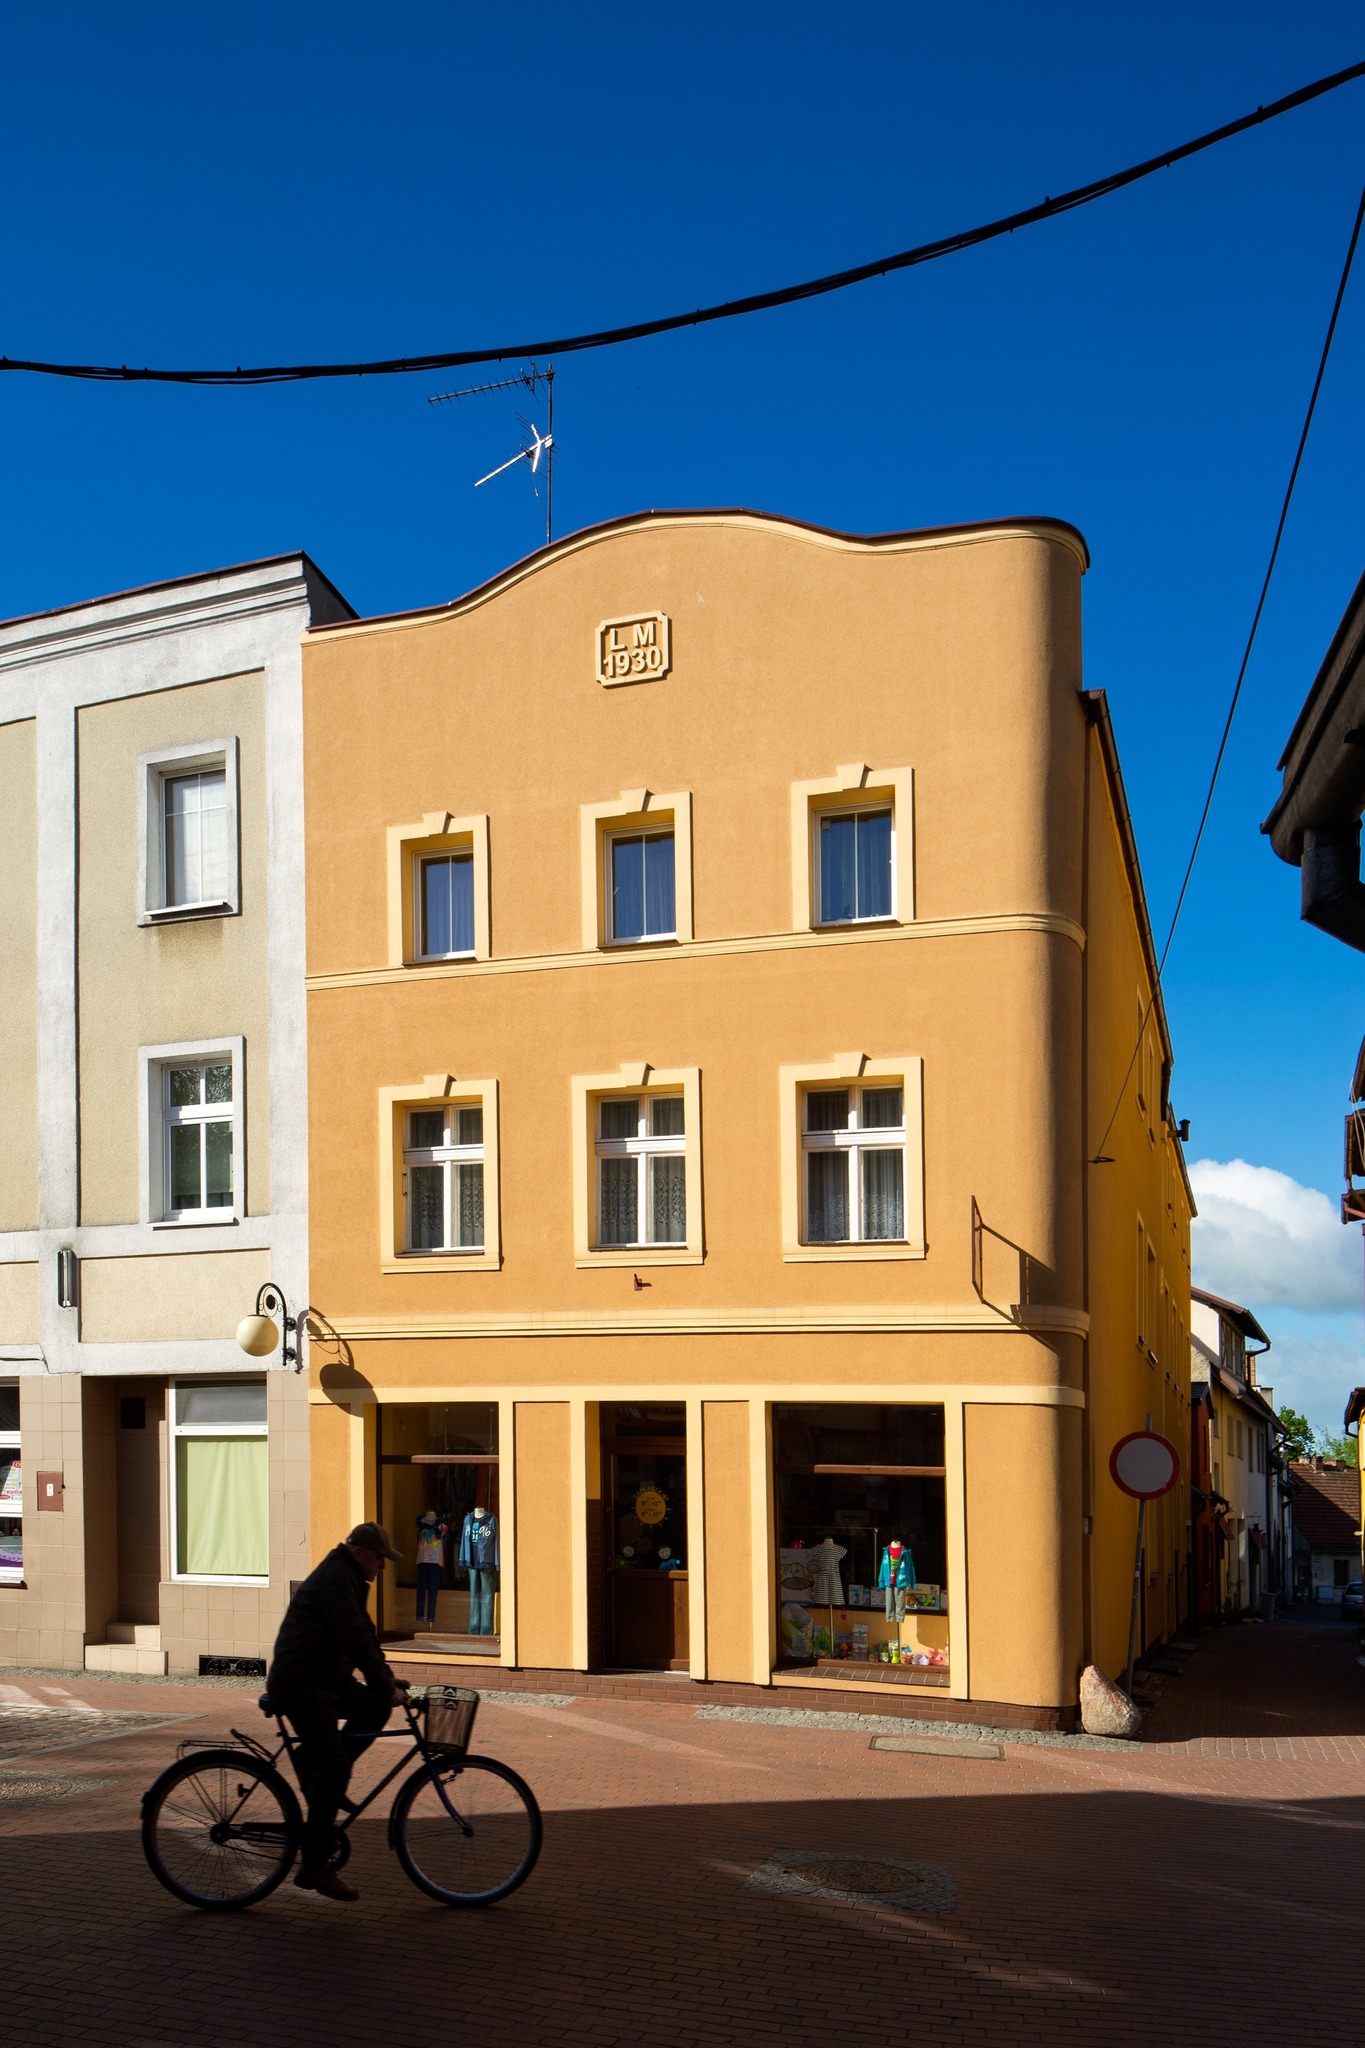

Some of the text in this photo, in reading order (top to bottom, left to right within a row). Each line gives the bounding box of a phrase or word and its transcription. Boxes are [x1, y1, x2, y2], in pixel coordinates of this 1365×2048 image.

[610, 621, 655, 651] L M
[603, 645, 661, 676] 1930
